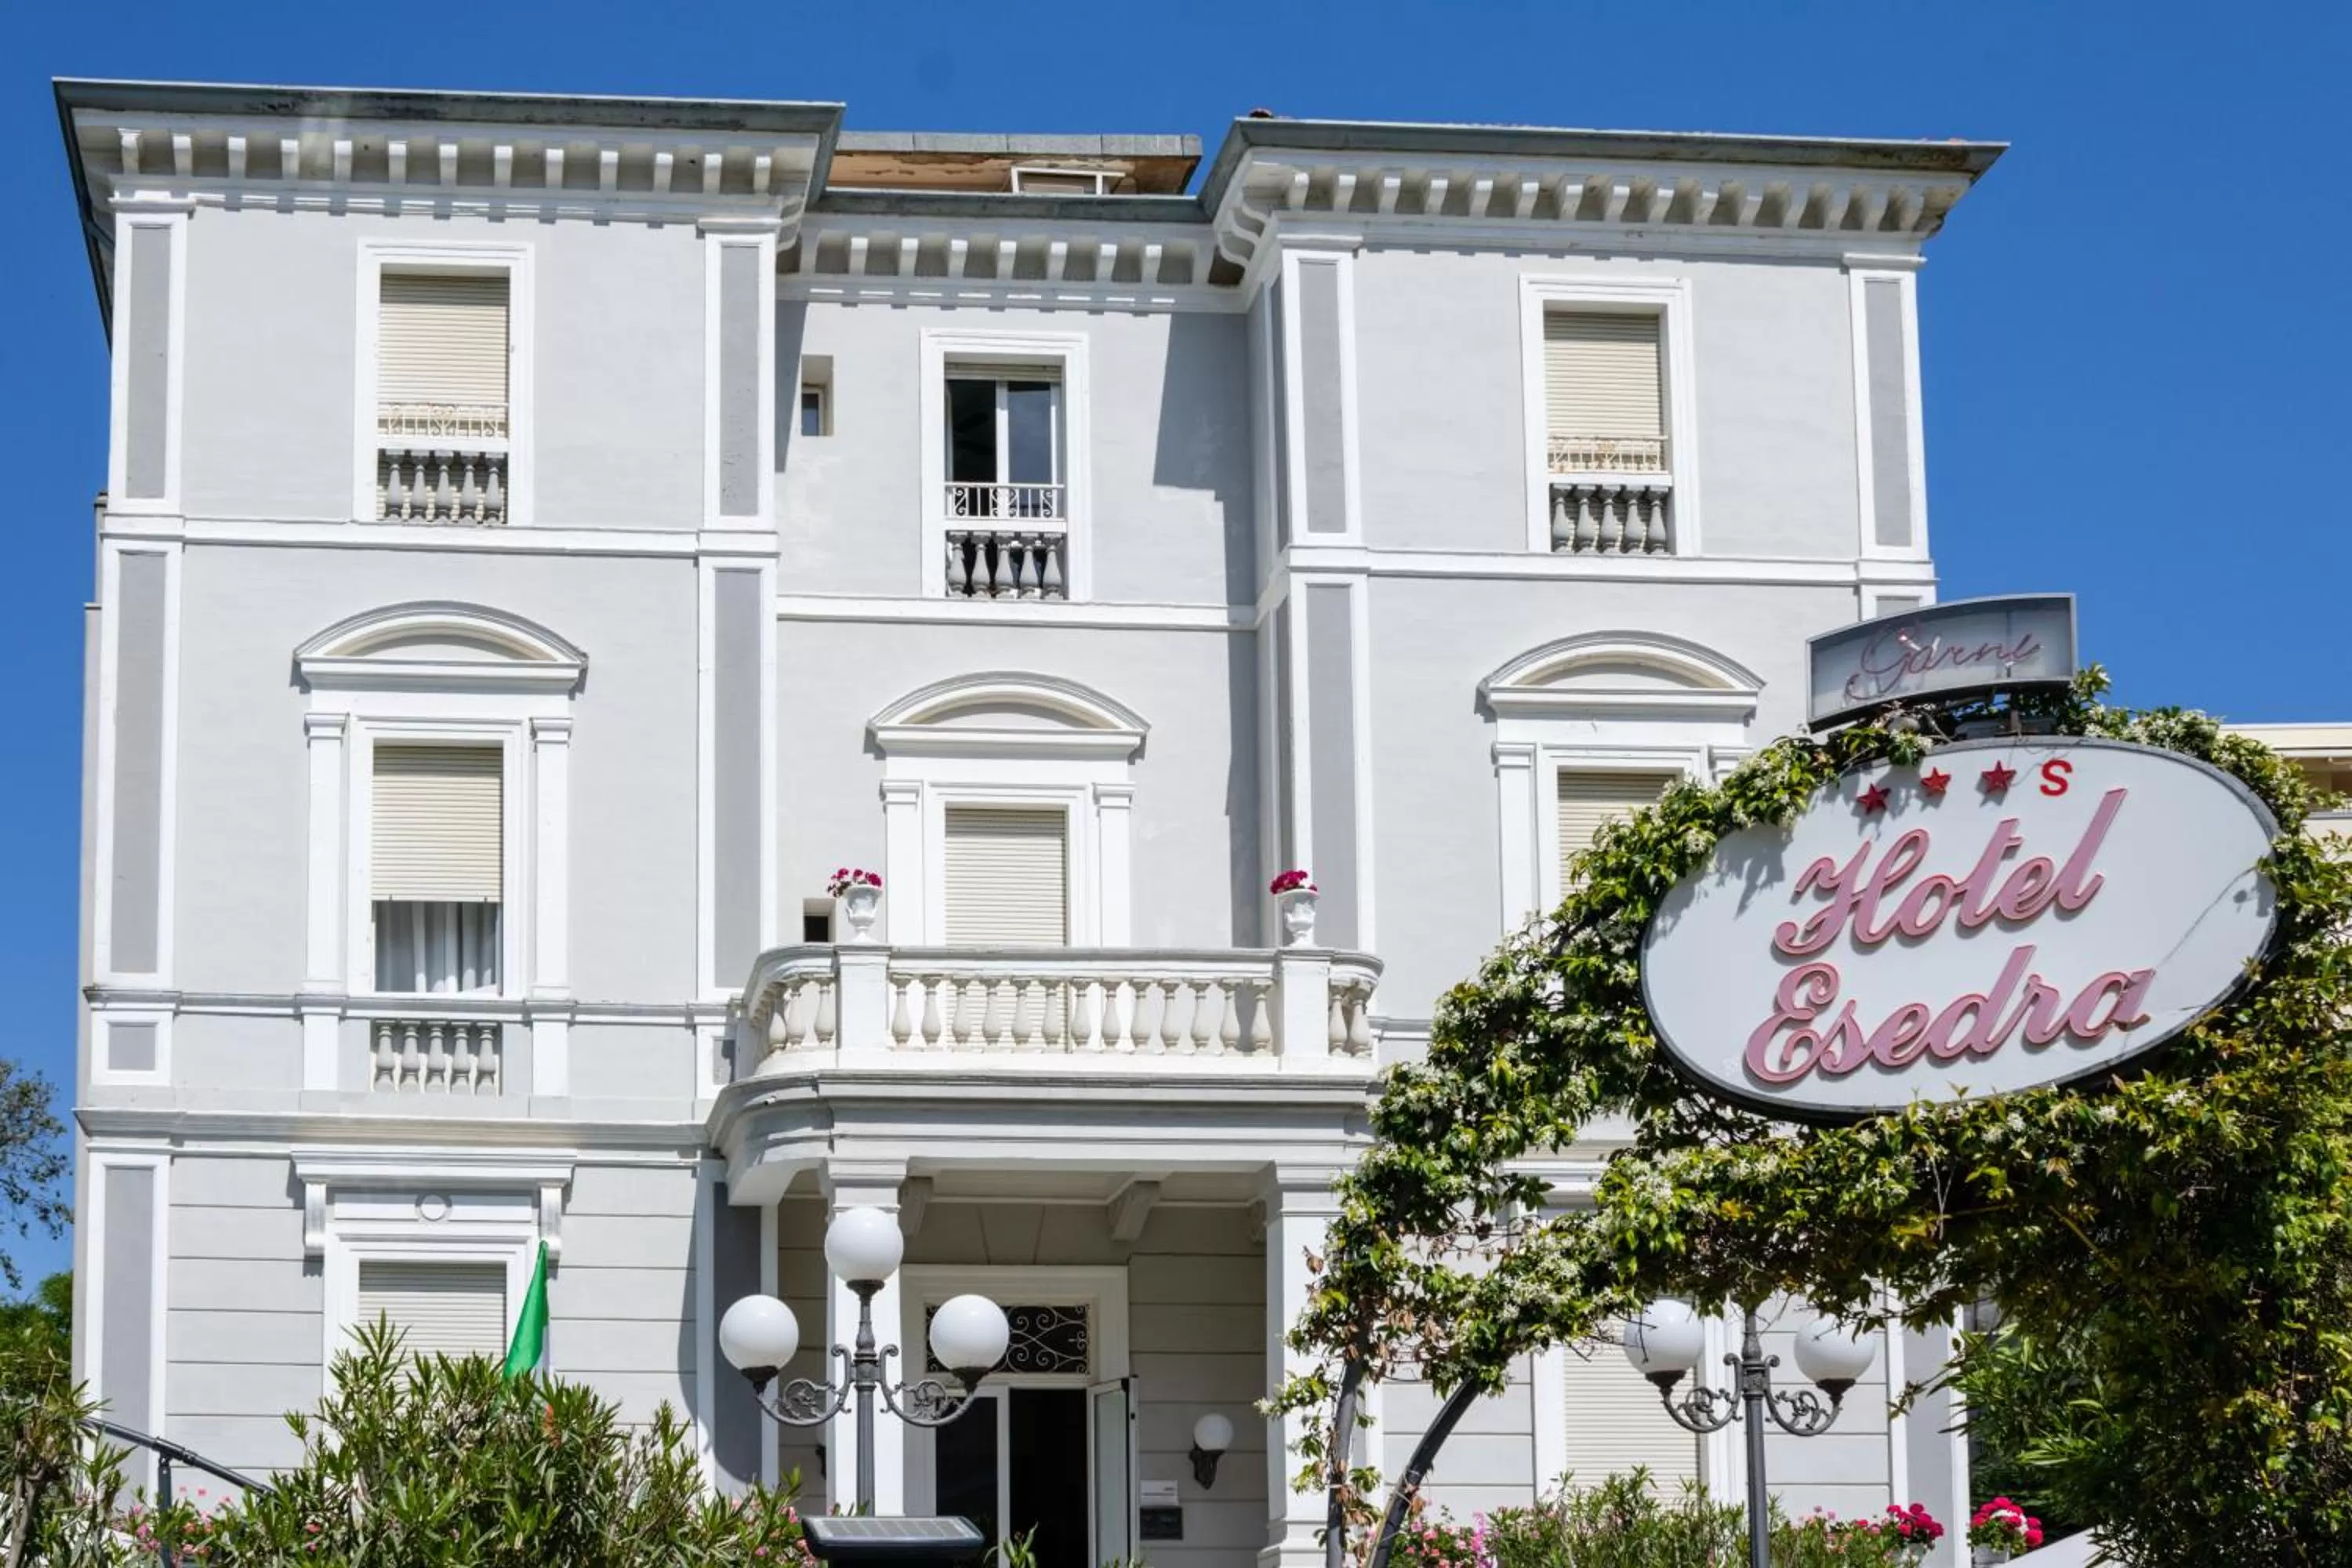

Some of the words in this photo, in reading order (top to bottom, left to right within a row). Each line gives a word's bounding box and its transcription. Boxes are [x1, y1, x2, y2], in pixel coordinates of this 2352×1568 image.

[2039, 758, 2074, 797] S
[1774, 788, 2129, 955] Hotel
[1745, 944, 2156, 1083] Esedra
